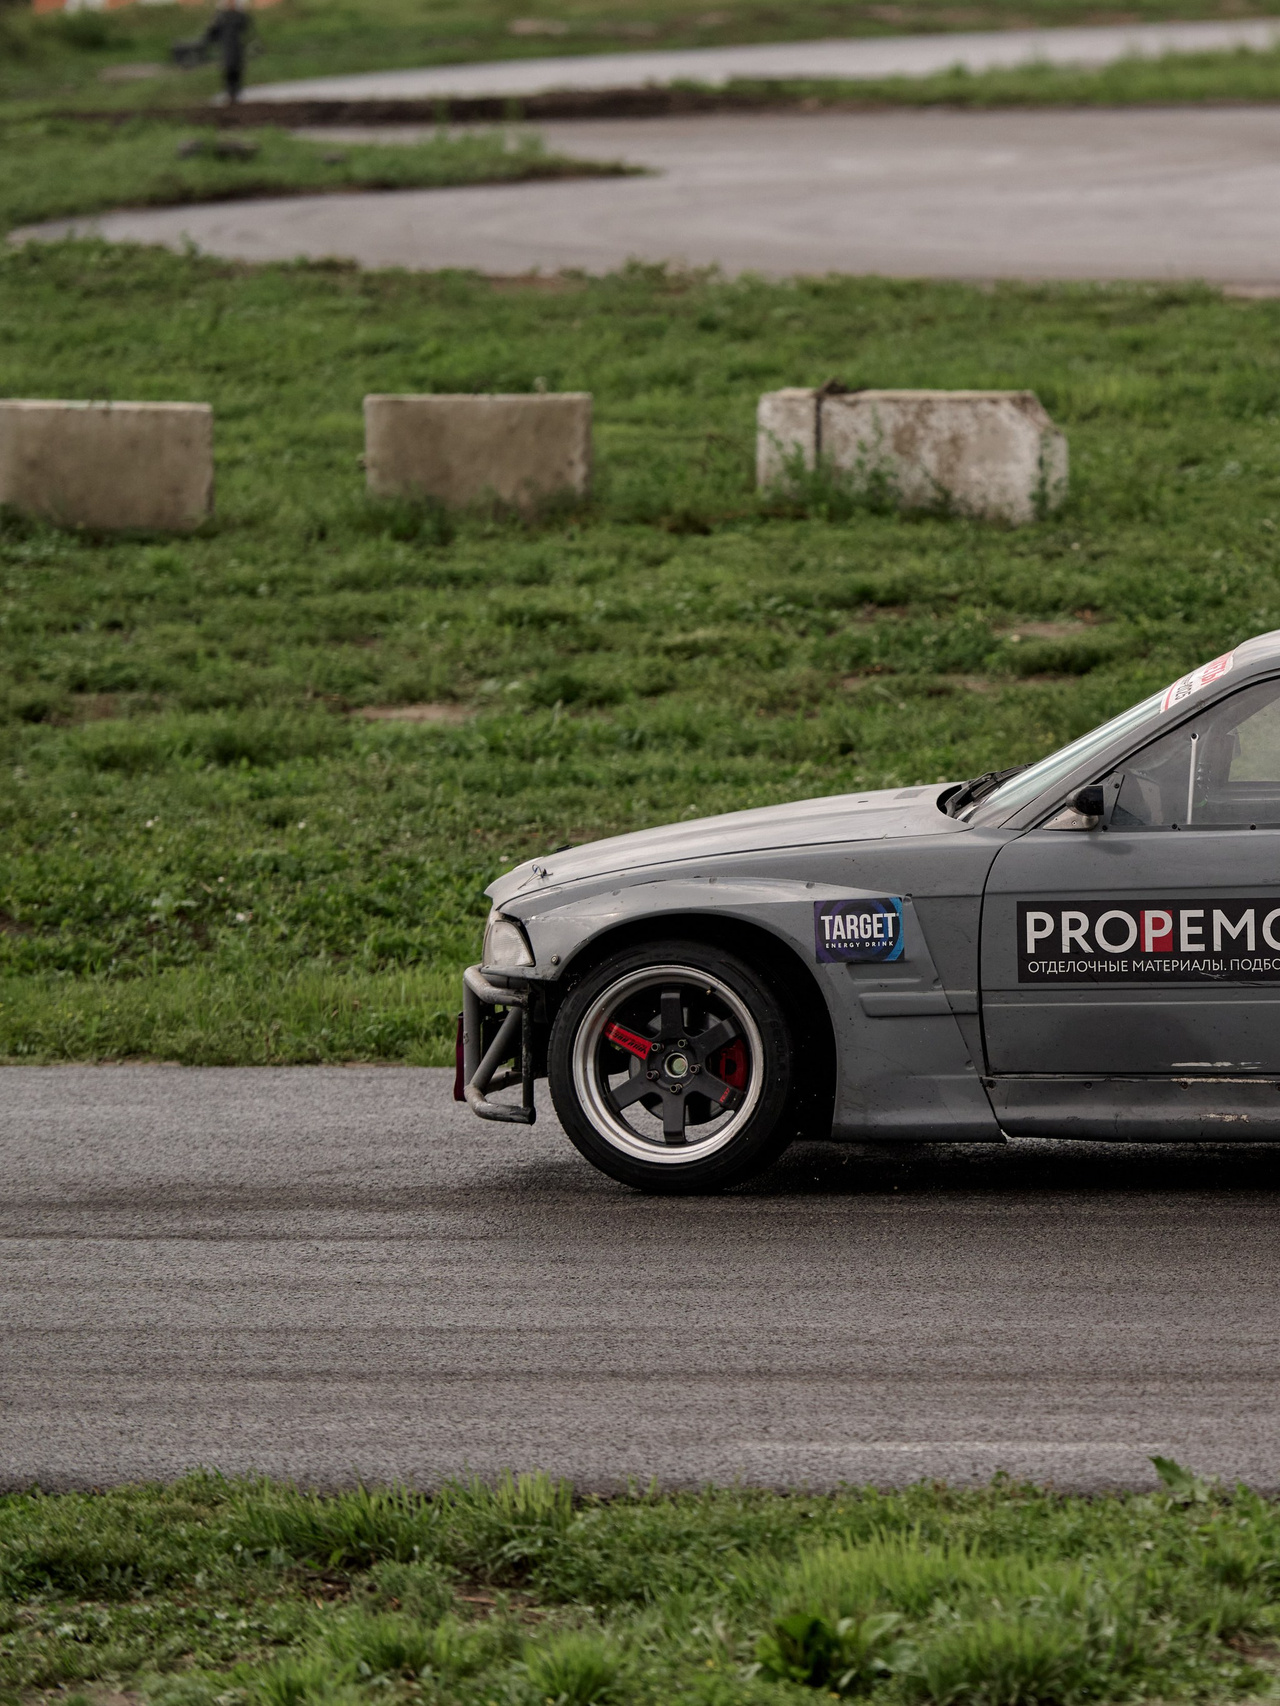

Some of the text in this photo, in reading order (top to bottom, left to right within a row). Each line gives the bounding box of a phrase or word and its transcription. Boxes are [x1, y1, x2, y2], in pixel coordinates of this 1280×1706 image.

[820, 913, 896, 940] TARGET
[825, 940, 894, 949] ENERGY DRINK
[1028, 960, 1128, 975] ОТДЕЛОЧНЫЕ
[1132, 959, 1227, 973] МАТЕРИАЛЫ.
